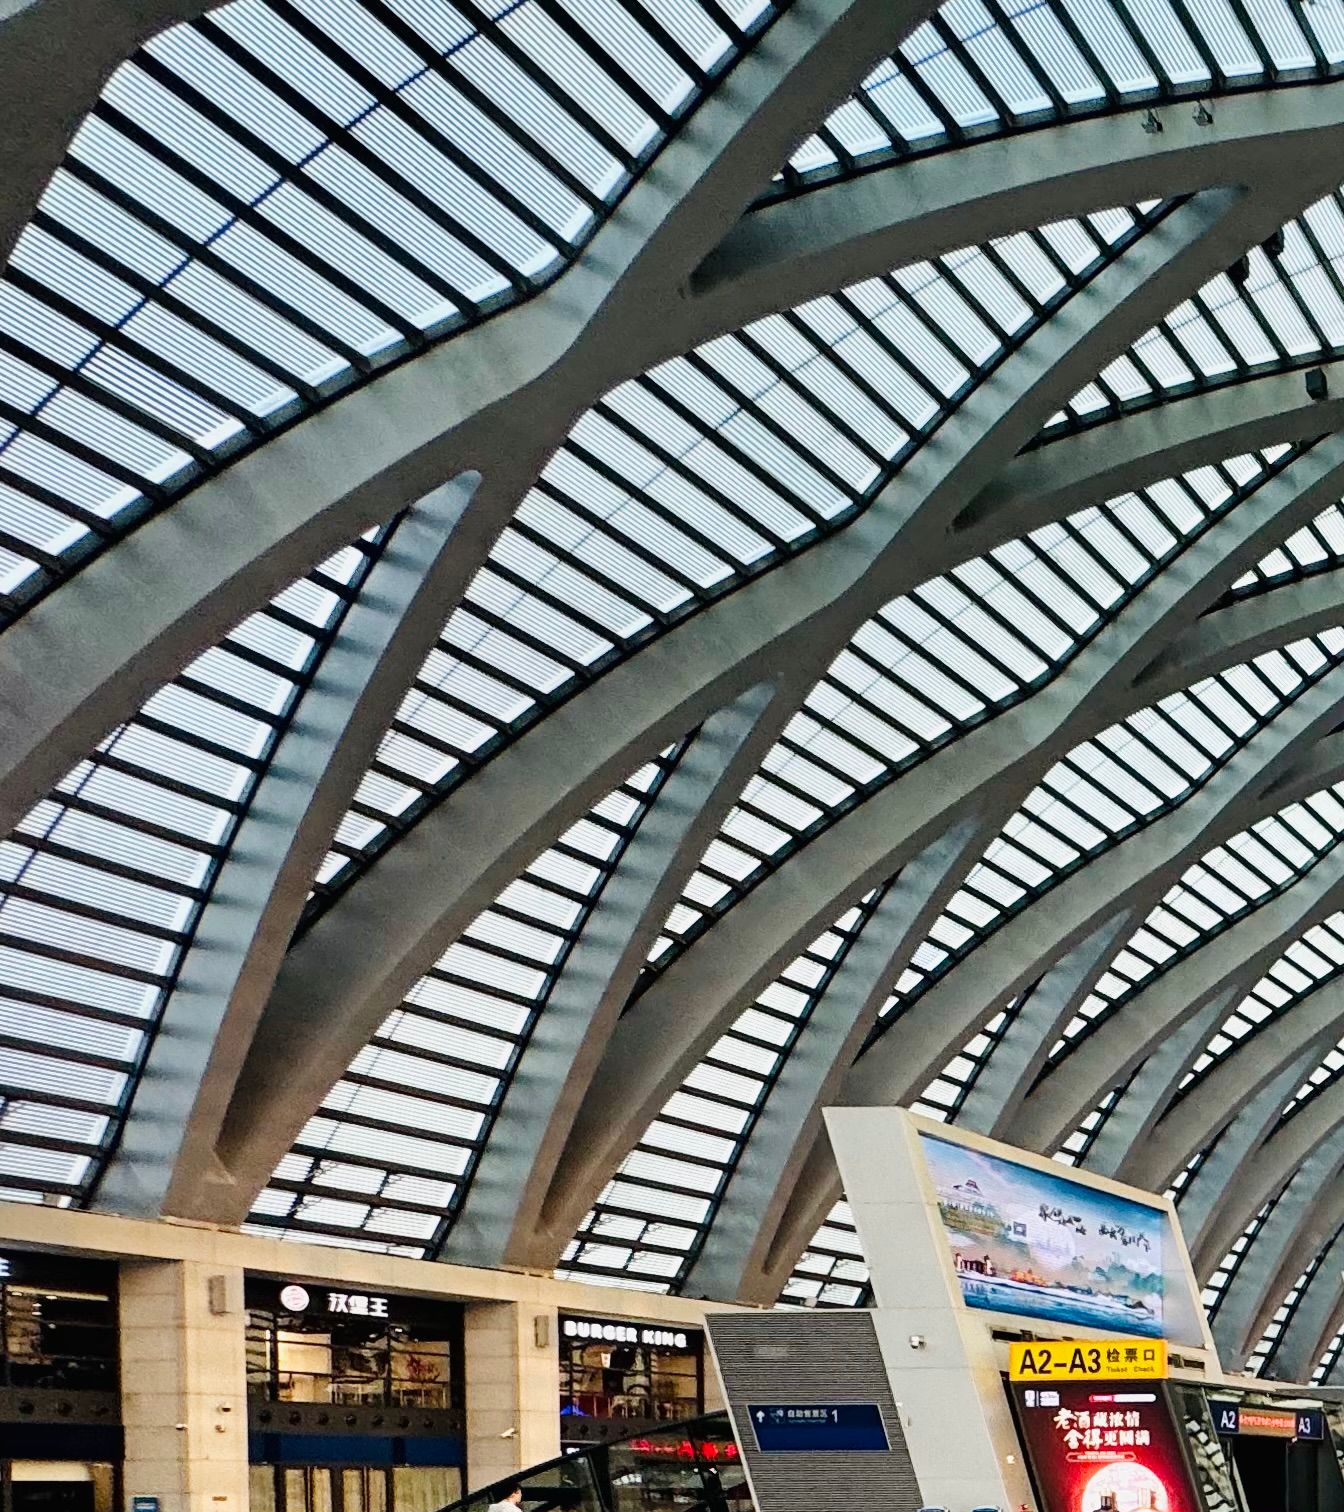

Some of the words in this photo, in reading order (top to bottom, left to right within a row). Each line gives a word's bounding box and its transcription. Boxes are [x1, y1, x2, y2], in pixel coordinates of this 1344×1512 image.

[327, 1293, 389, 1318] 汉堡王
[563, 1320, 638, 1343] BURGER
[641, 1326, 688, 1348] KING
[1019, 1348, 1102, 1375] A2-A3
[1106, 1348, 1156, 1363] 检票口
[1221, 1410, 1236, 1429] A2
[1298, 1417, 1311, 1434] A3
